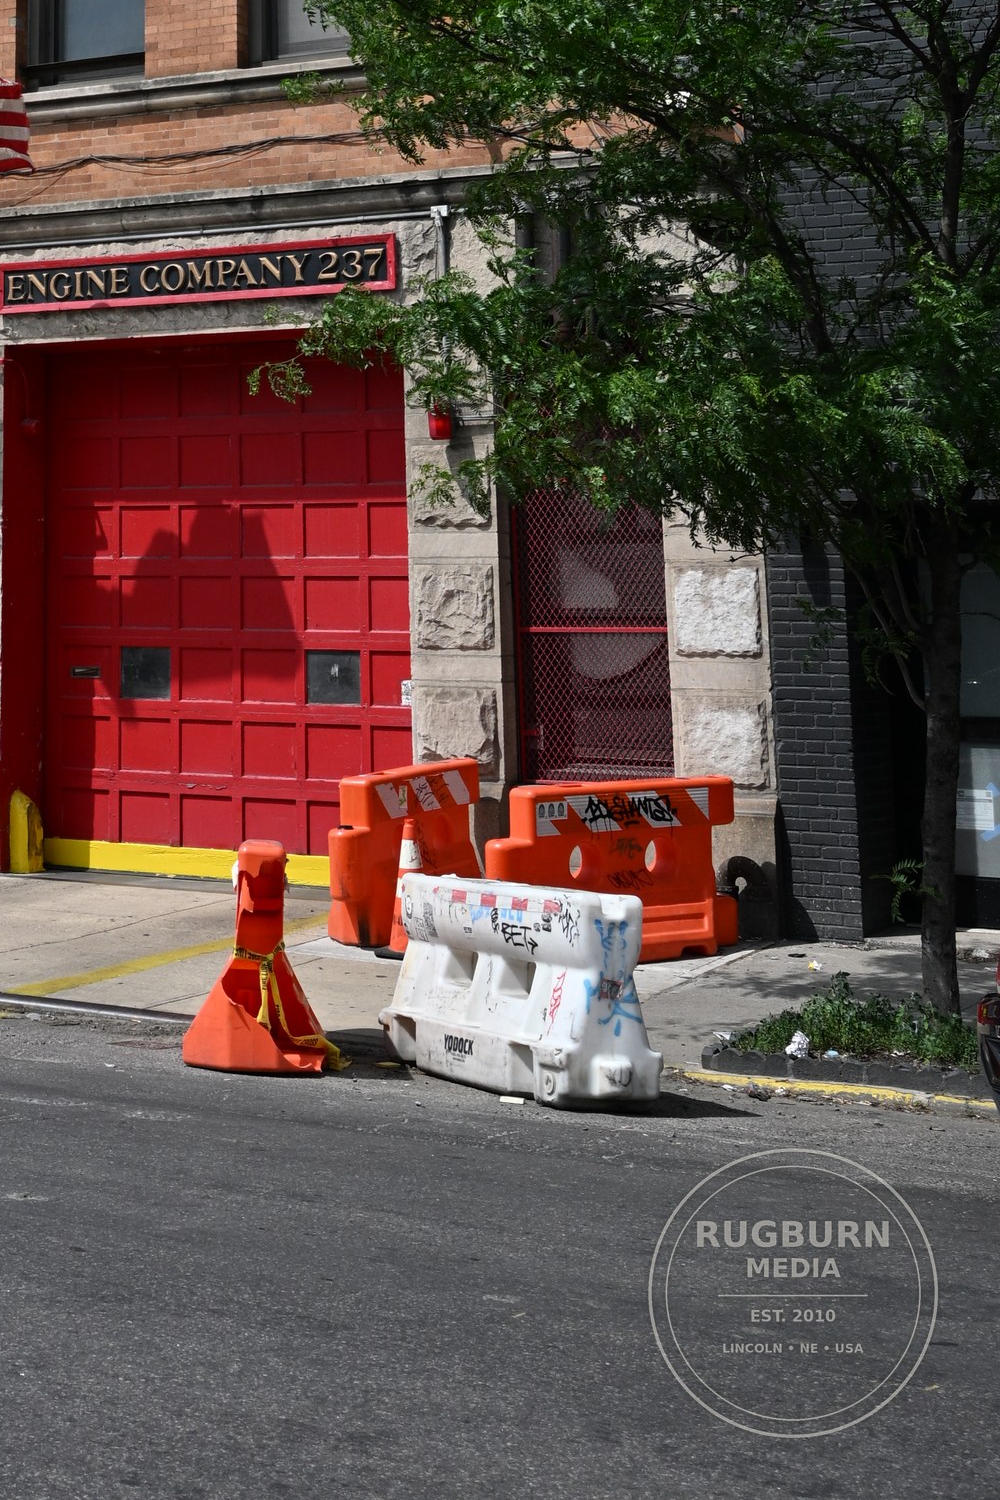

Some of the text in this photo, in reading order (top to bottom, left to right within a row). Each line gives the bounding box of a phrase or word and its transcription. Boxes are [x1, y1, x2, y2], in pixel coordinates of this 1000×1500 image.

[6, 248, 385, 301] ENGINE COMPANY 237
[444, 1034, 474, 1056] YODOCK
